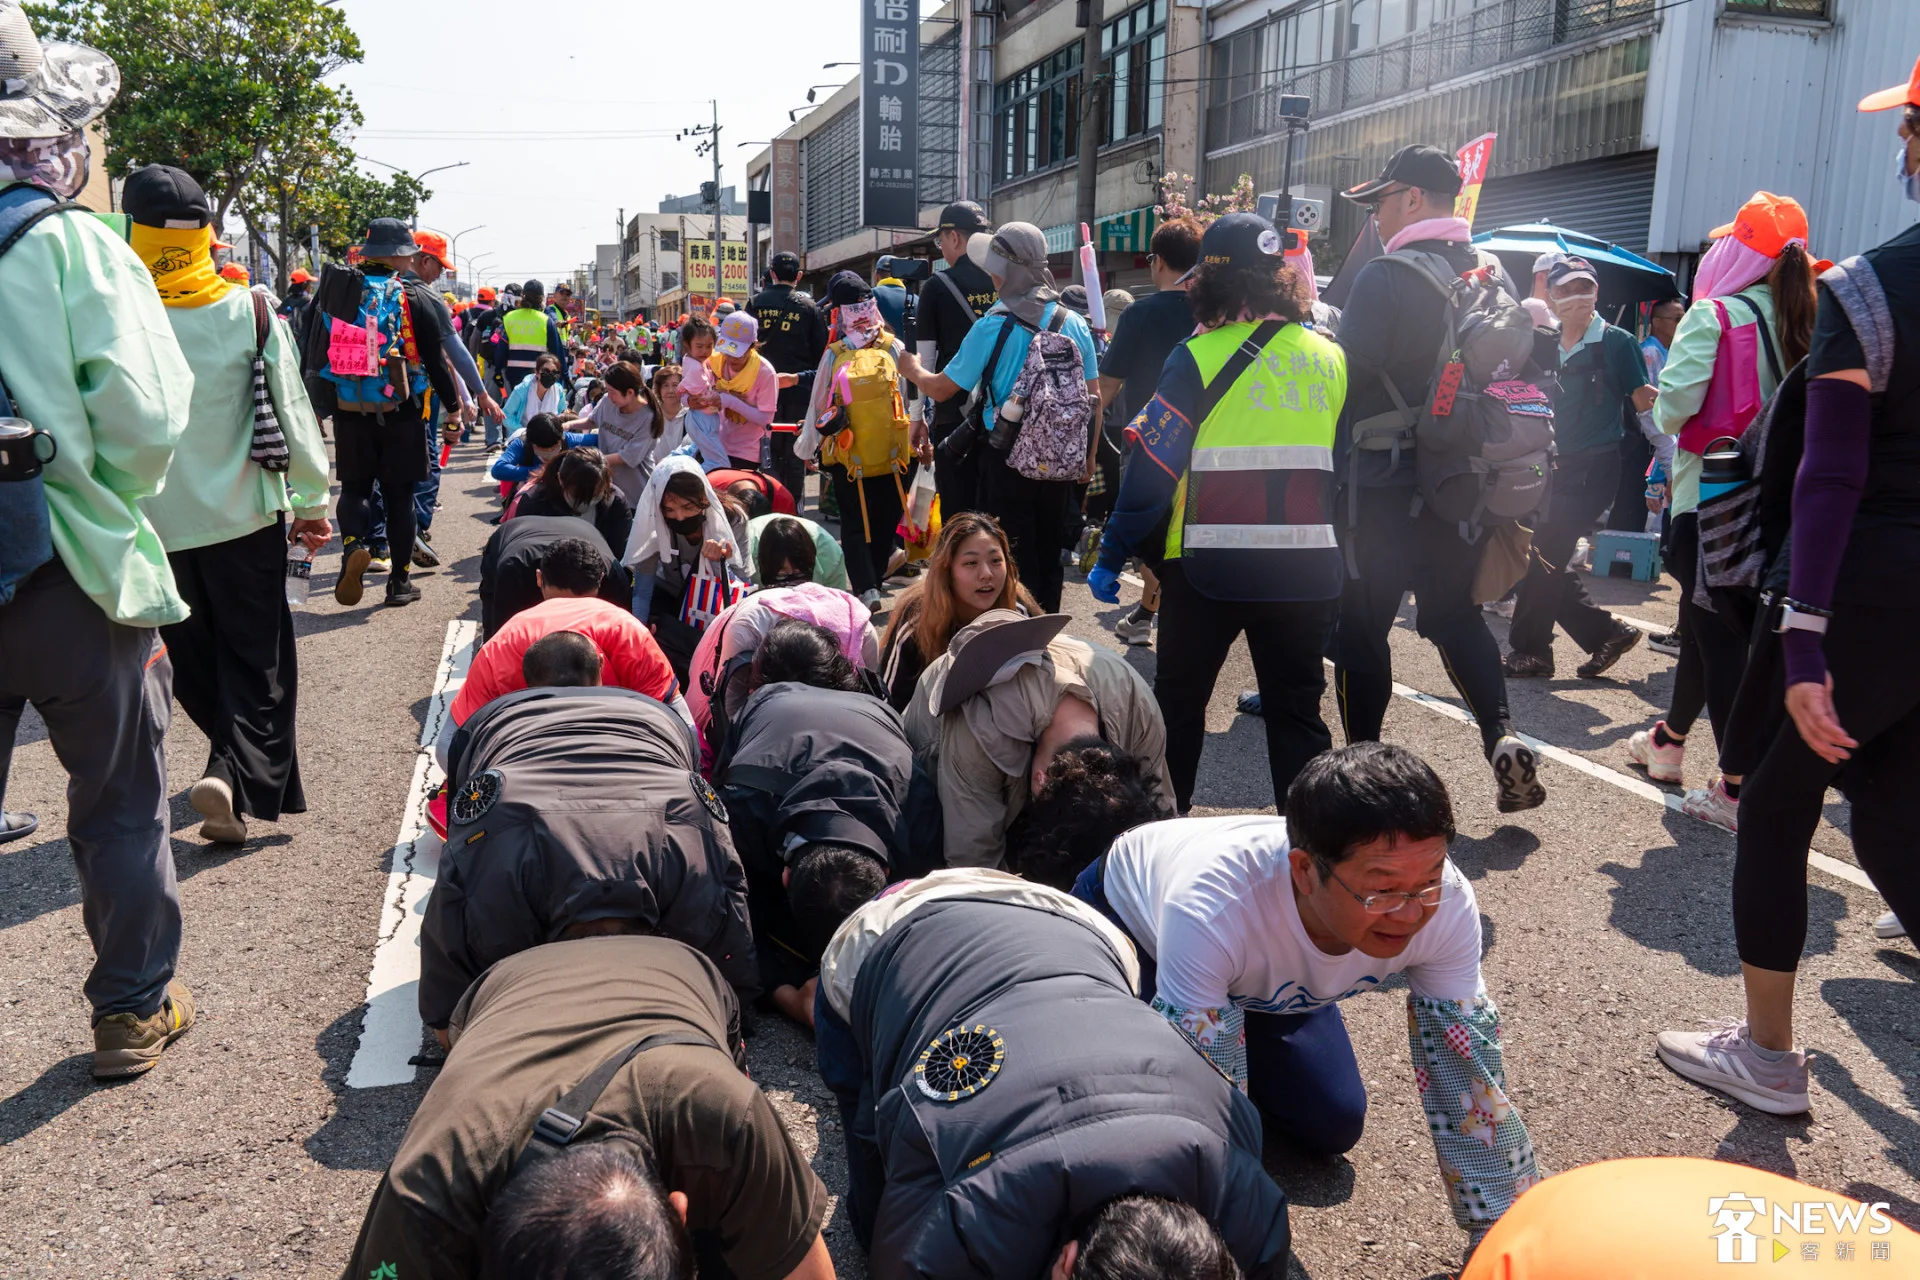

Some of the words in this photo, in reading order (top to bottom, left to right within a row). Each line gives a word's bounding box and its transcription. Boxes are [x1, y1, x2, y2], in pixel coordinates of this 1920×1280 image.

[763, 319, 791, 332] CD
[1247, 379, 1329, 413] 交通隊
